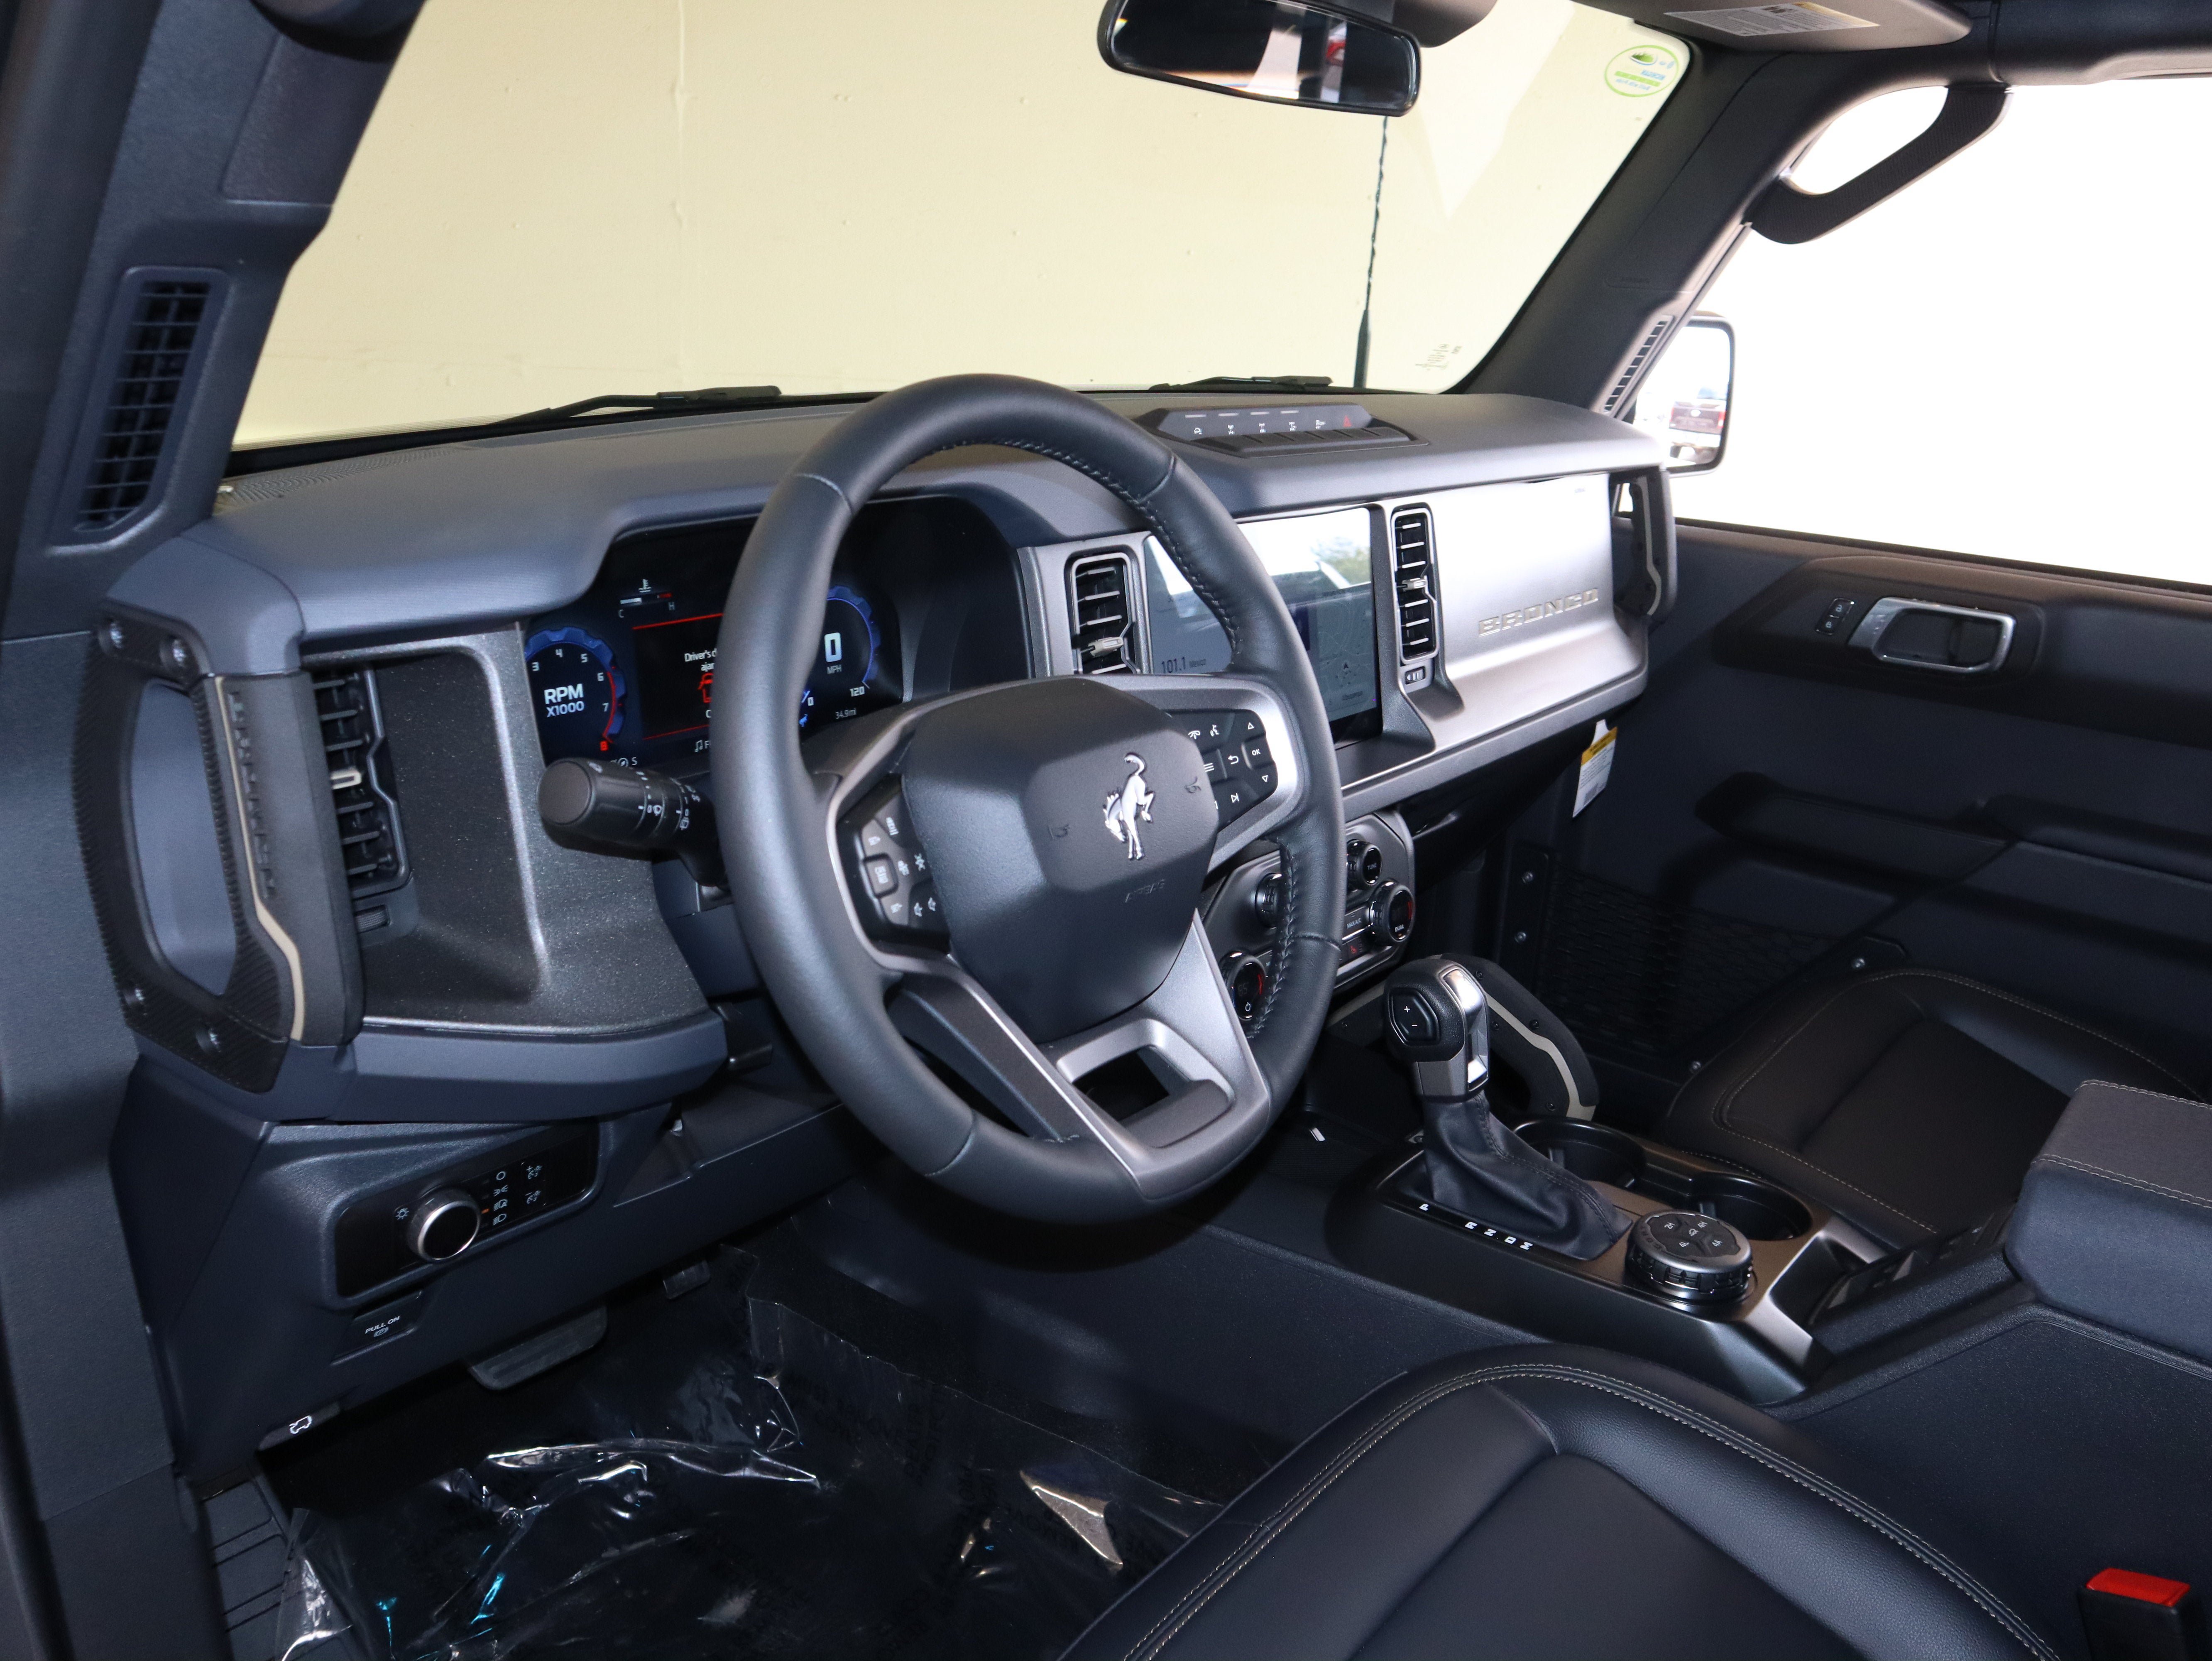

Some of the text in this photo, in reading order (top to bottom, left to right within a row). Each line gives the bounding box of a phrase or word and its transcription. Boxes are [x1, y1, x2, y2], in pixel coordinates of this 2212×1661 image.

[668, 602, 675, 610] H
[1478, 588, 1598, 636] BRONCO
[824, 632, 842, 662] 0
[555, 649, 563, 658] 4
[581, 654, 588, 663] 5
[685, 650, 711, 662] Driver's
[532, 662, 539, 671] 3
[827, 664, 842, 674] MPH
[1162, 657, 1186, 673] 101.1
[597, 672, 604, 681] 6
[544, 683, 584, 704] RPM
[850, 686, 865, 697] 120
[807, 697, 814, 706] 0
[546, 701, 584, 718] X1000
[602, 703, 609, 712] 7
[600, 740, 608, 751] 8
[1395, 924, 1404, 932] DUAL
[1484, 1228, 1497, 1237] N
[1520, 1242, 1533, 1250] M
[365, 1316, 400, 1334] PULL ON
